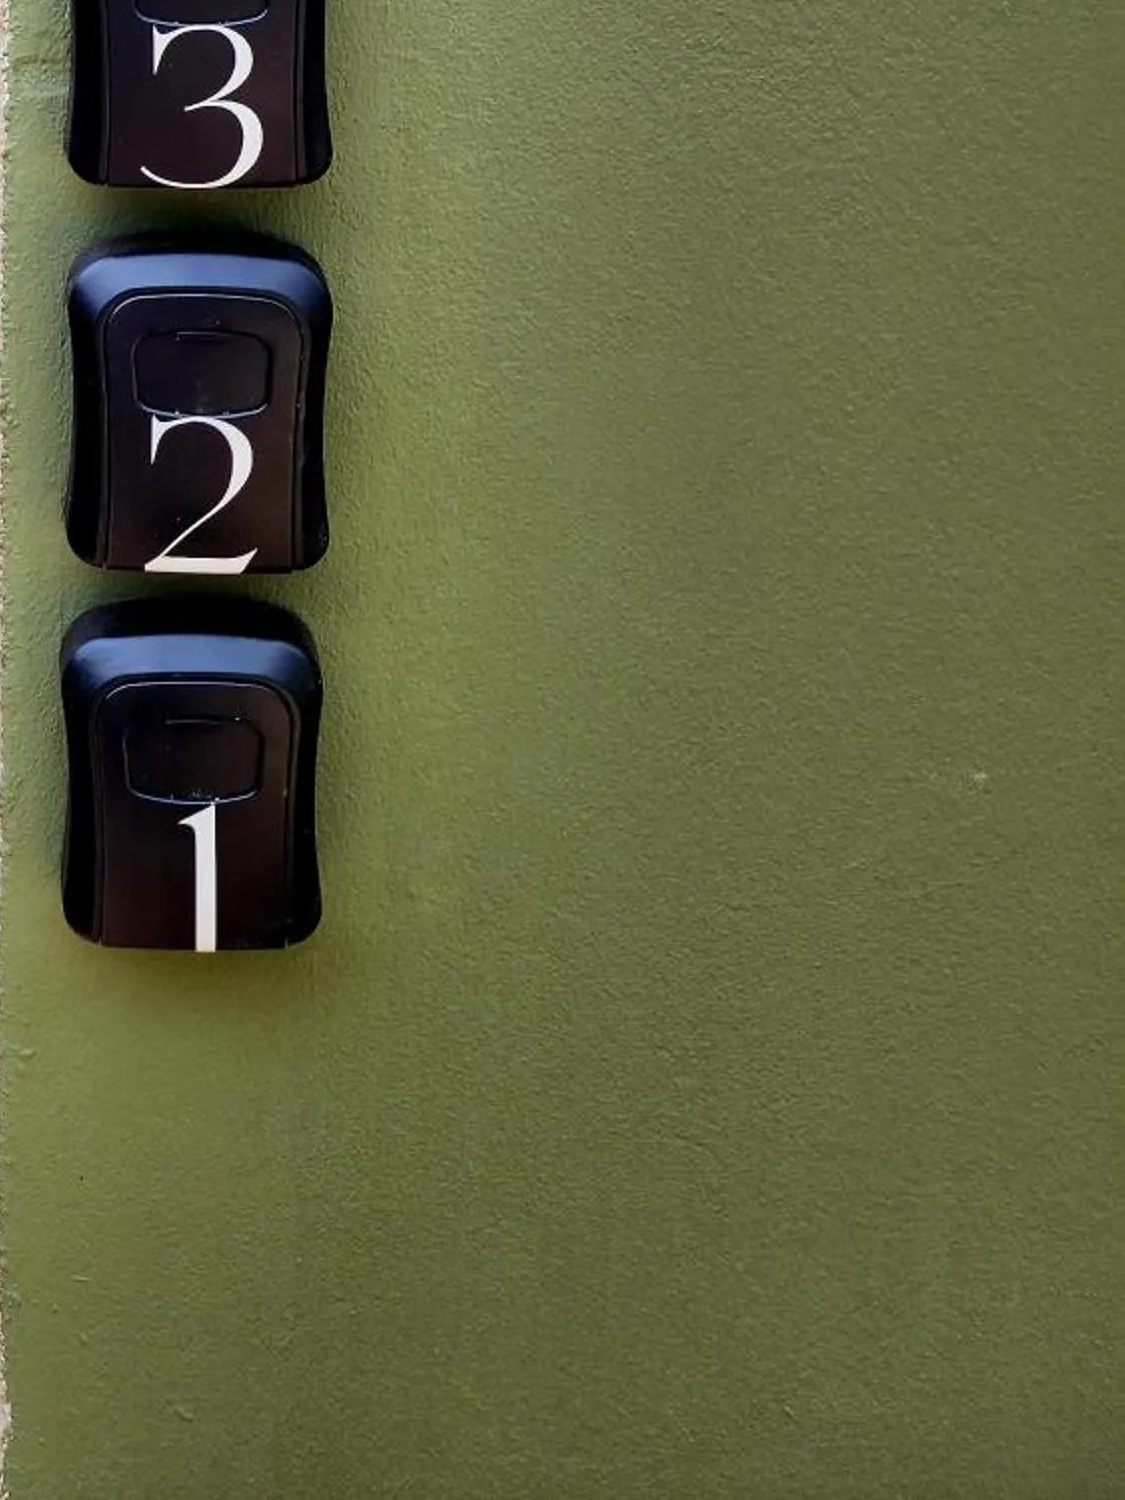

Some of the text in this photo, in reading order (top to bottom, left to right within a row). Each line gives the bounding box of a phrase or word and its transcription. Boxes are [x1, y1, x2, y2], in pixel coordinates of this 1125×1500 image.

[140, 23, 265, 189] 3
[144, 414, 259, 575] 2
[177, 797, 218, 954] 1
